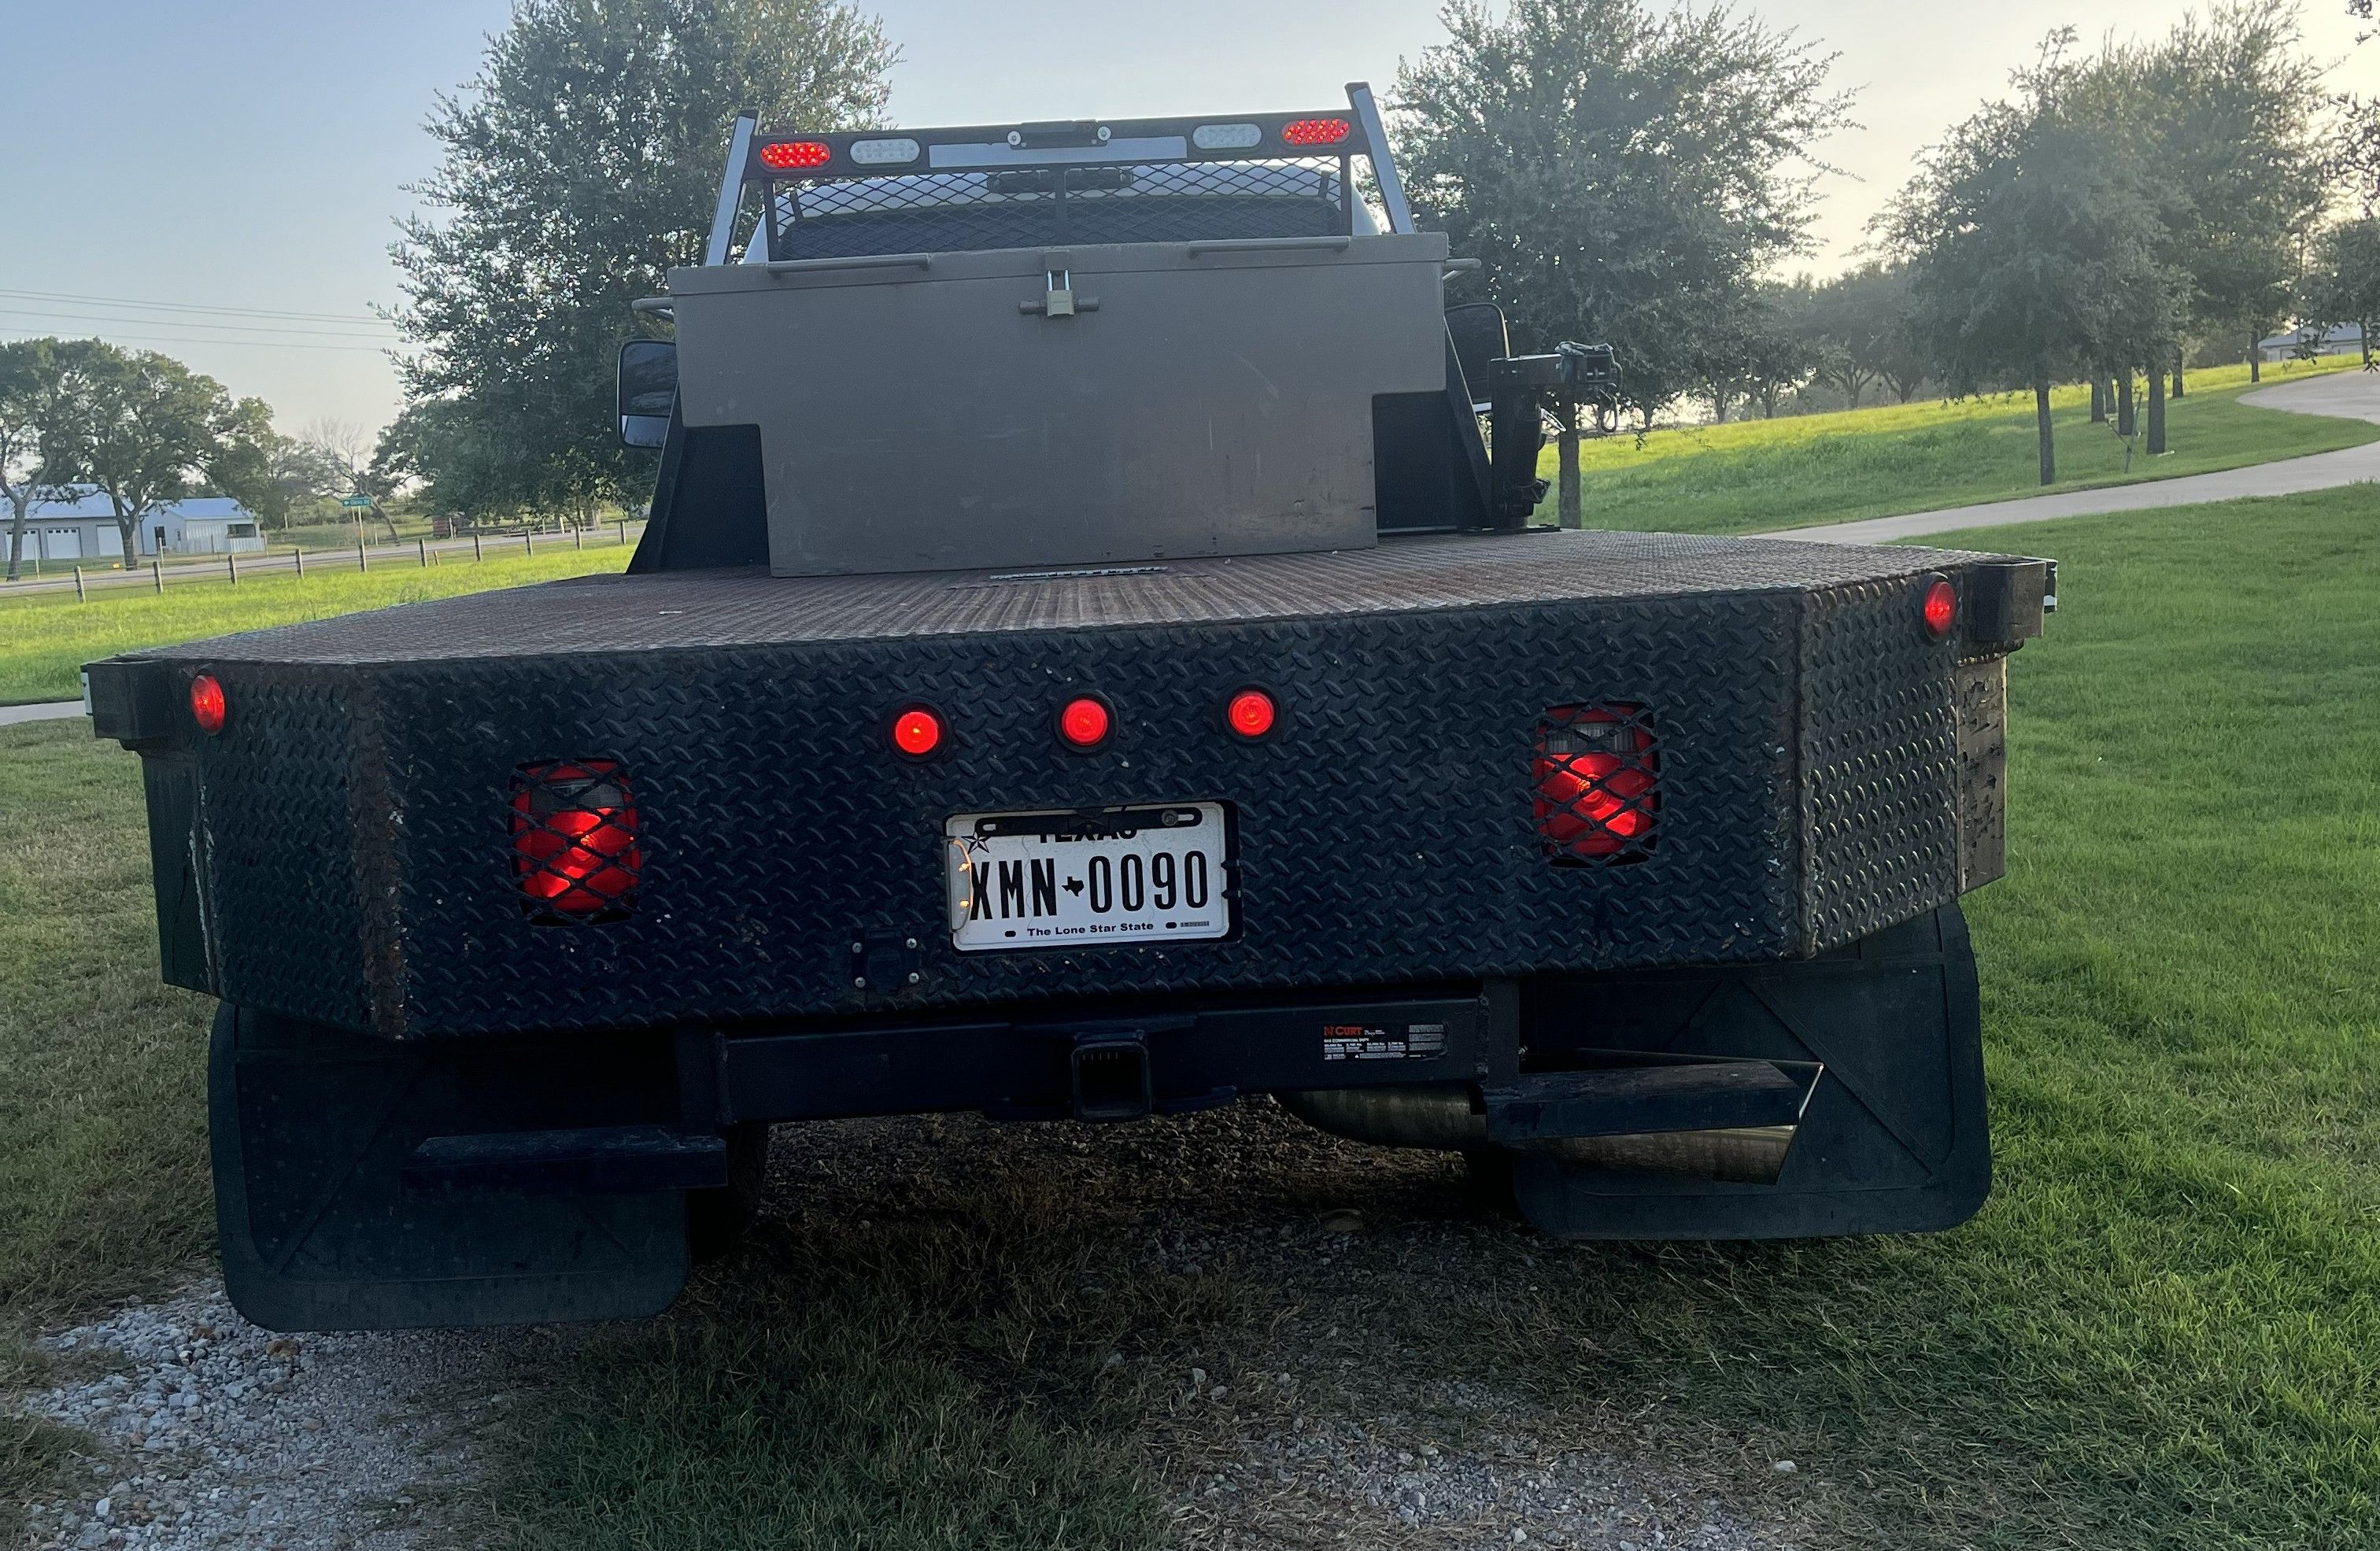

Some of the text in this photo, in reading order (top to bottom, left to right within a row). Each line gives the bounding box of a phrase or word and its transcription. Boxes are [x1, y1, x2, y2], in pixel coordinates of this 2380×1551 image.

[969, 850, 1208, 921] XMN 0090
[1027, 921, 1154, 936] The Lone Star State
